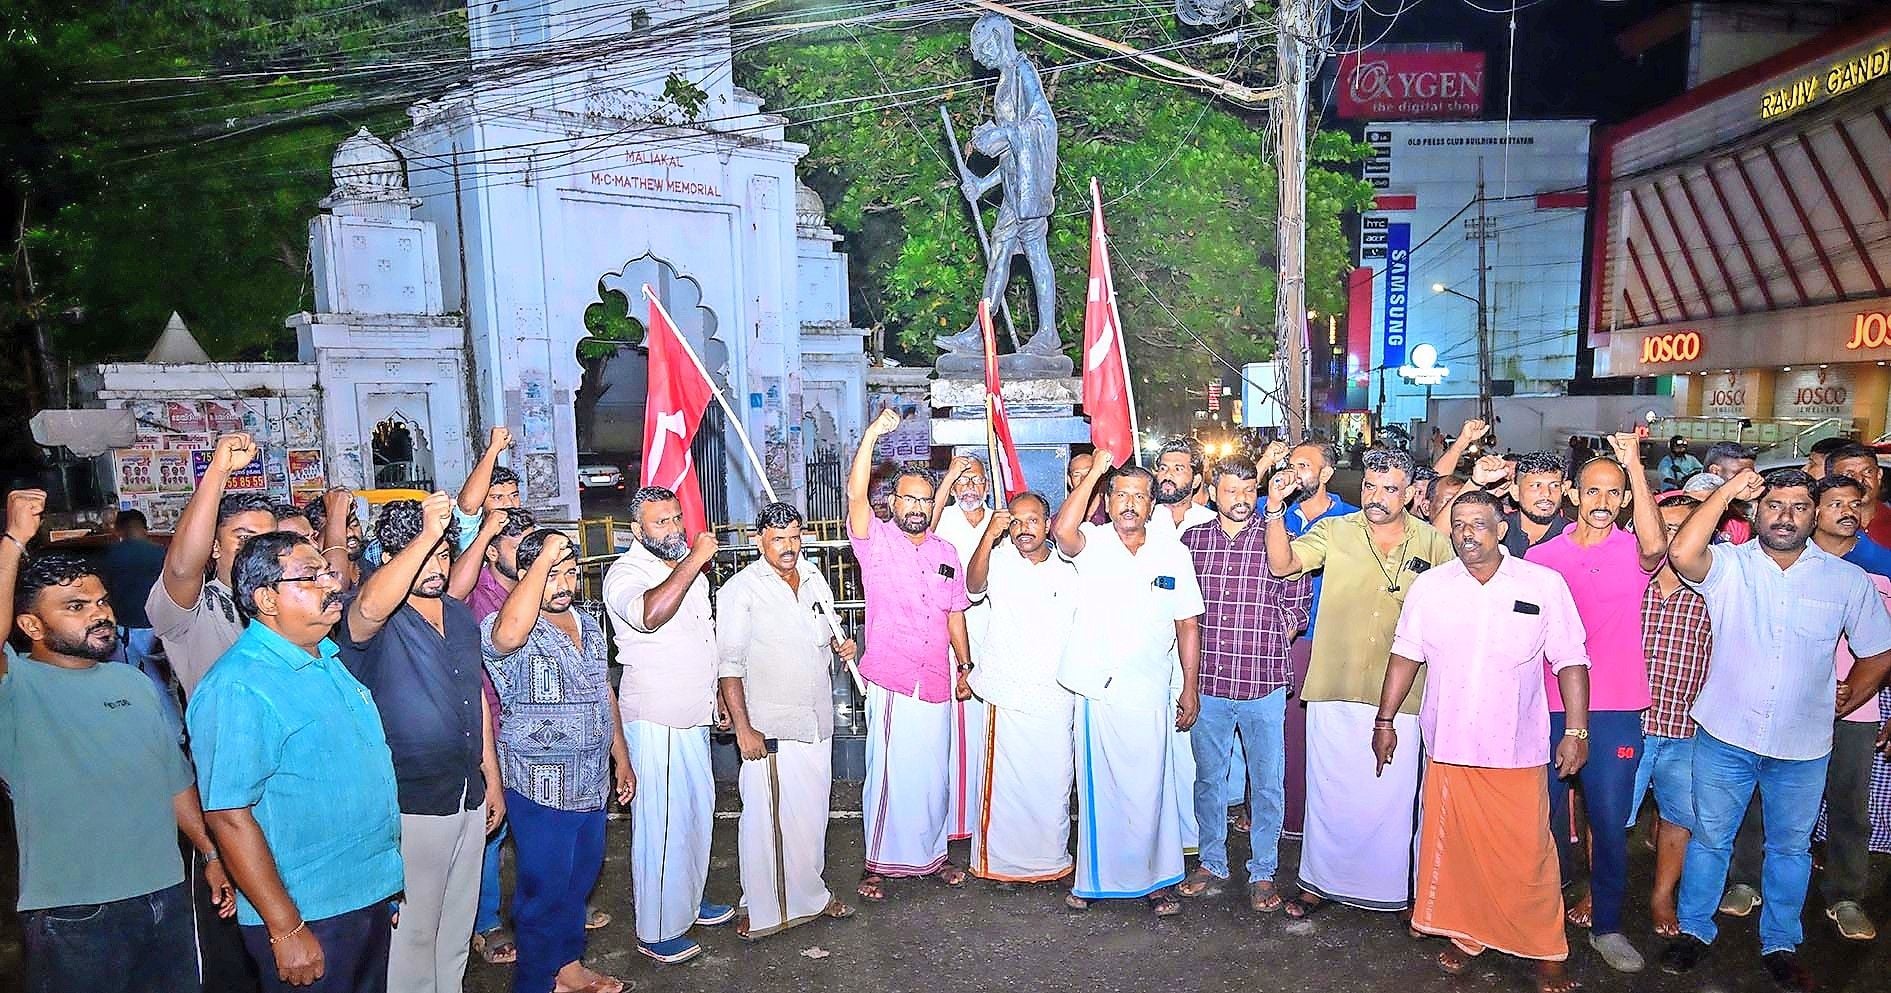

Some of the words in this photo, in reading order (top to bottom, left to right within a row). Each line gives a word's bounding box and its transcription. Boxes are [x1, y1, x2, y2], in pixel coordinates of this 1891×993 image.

[1348, 61, 1484, 103] OXYGEN
[1761, 76, 1819, 119] RAJIV
[1825, 48, 1891, 95] GAND
[1373, 102, 1394, 113] the
[1399, 101, 1443, 114] digital
[1447, 102, 1479, 114] shop
[1407, 138, 1421, 146] OLD
[1446, 138, 1464, 146] CLUB
[1466, 137, 1498, 145] BUILDING
[625, 150, 684, 168] MALIAKAL
[666, 179, 722, 197] MEMORIAL
[1388, 250, 1407, 346] SAMSUNG
[1640, 332, 1700, 363] JOSCO
[1710, 390, 1745, 406] JOSC
[1793, 386, 1847, 406] JOSCO
[240, 476, 251, 487] 85
[253, 475, 264, 487] 55
